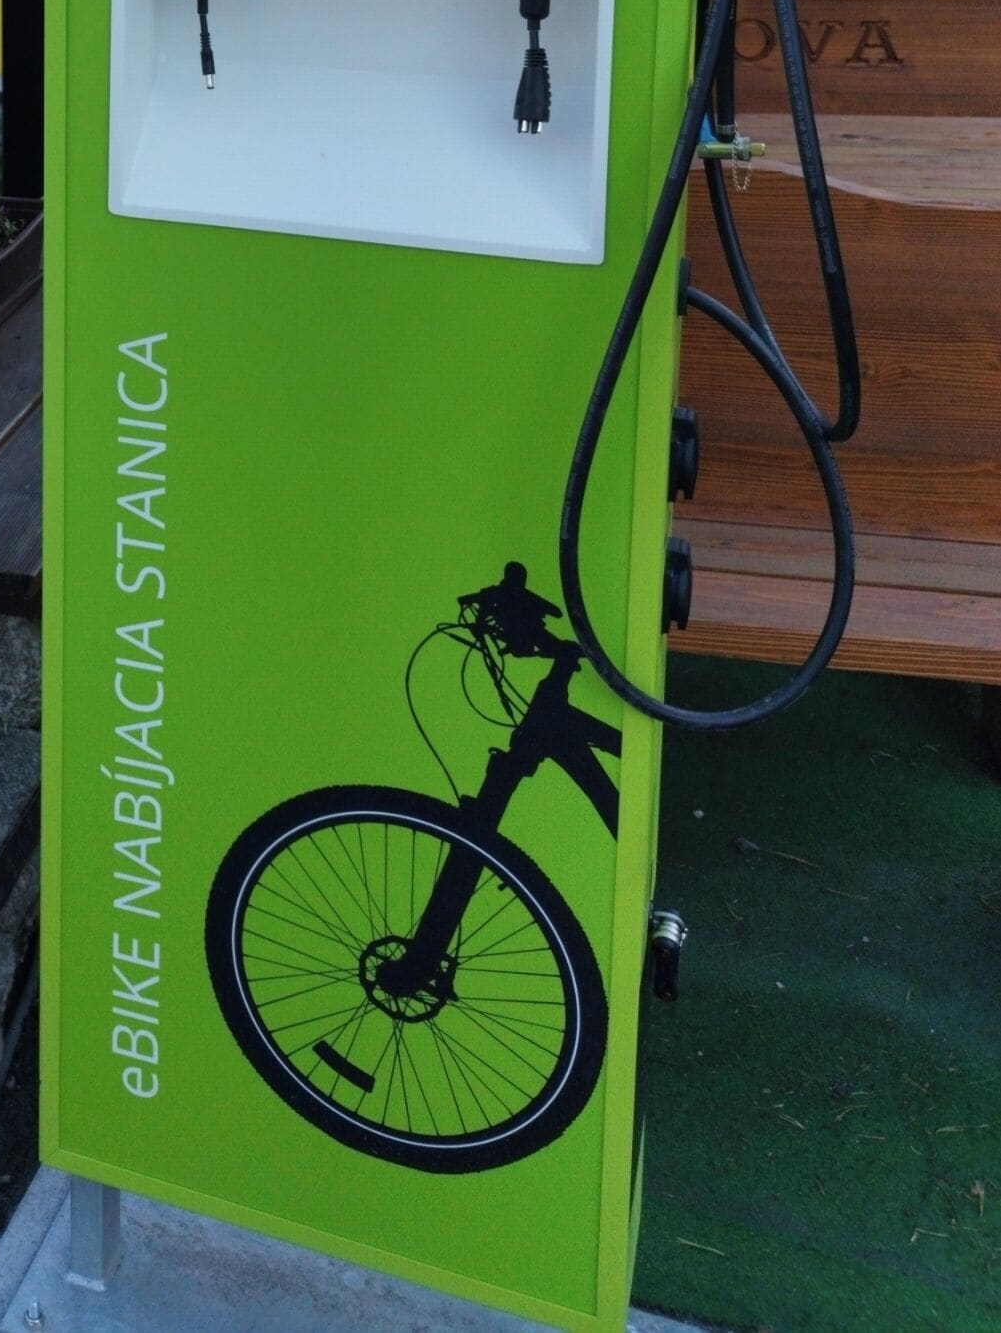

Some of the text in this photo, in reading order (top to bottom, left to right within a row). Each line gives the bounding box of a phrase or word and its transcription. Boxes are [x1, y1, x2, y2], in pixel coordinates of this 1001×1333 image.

[100, 332, 175, 1099] eBIKE NABÍJACIA STANICA
